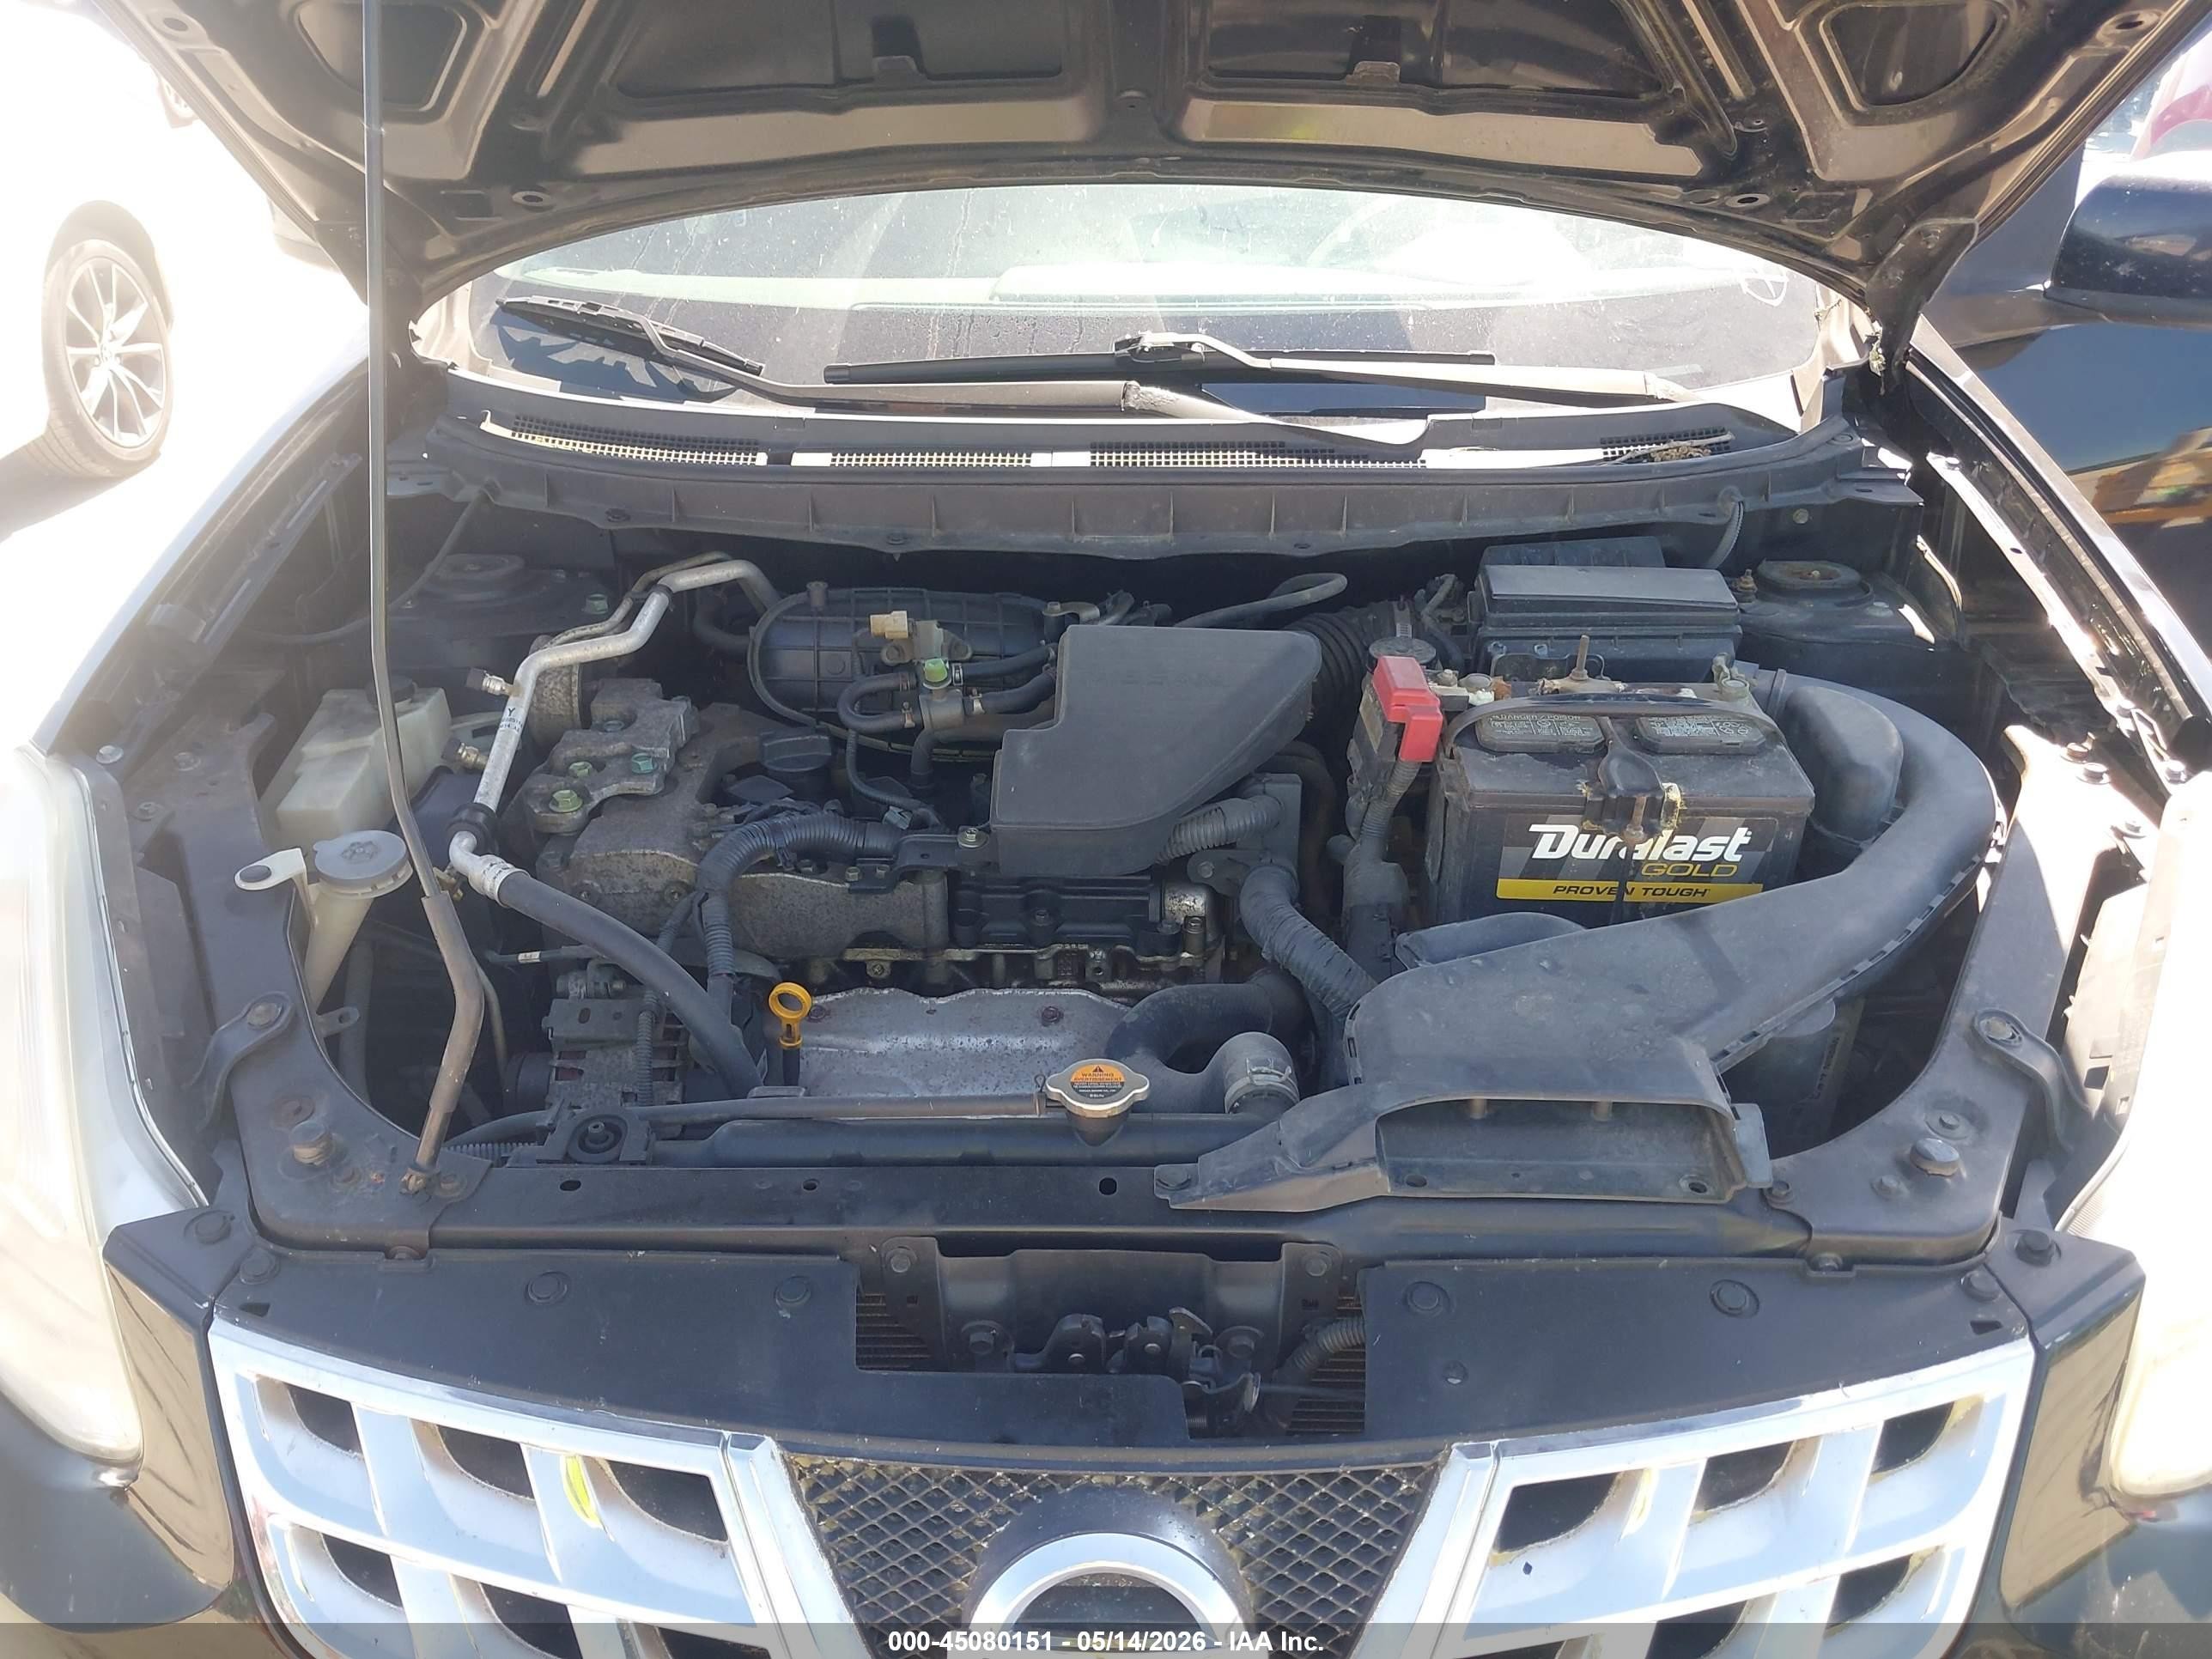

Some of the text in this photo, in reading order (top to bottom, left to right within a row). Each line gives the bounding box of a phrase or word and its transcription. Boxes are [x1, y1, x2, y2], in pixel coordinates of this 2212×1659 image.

[1528, 823, 1752, 862] Duralast
[1641, 862, 1738, 878] GOLD
[1553, 885, 1708, 897] PROVEN TOUGH
